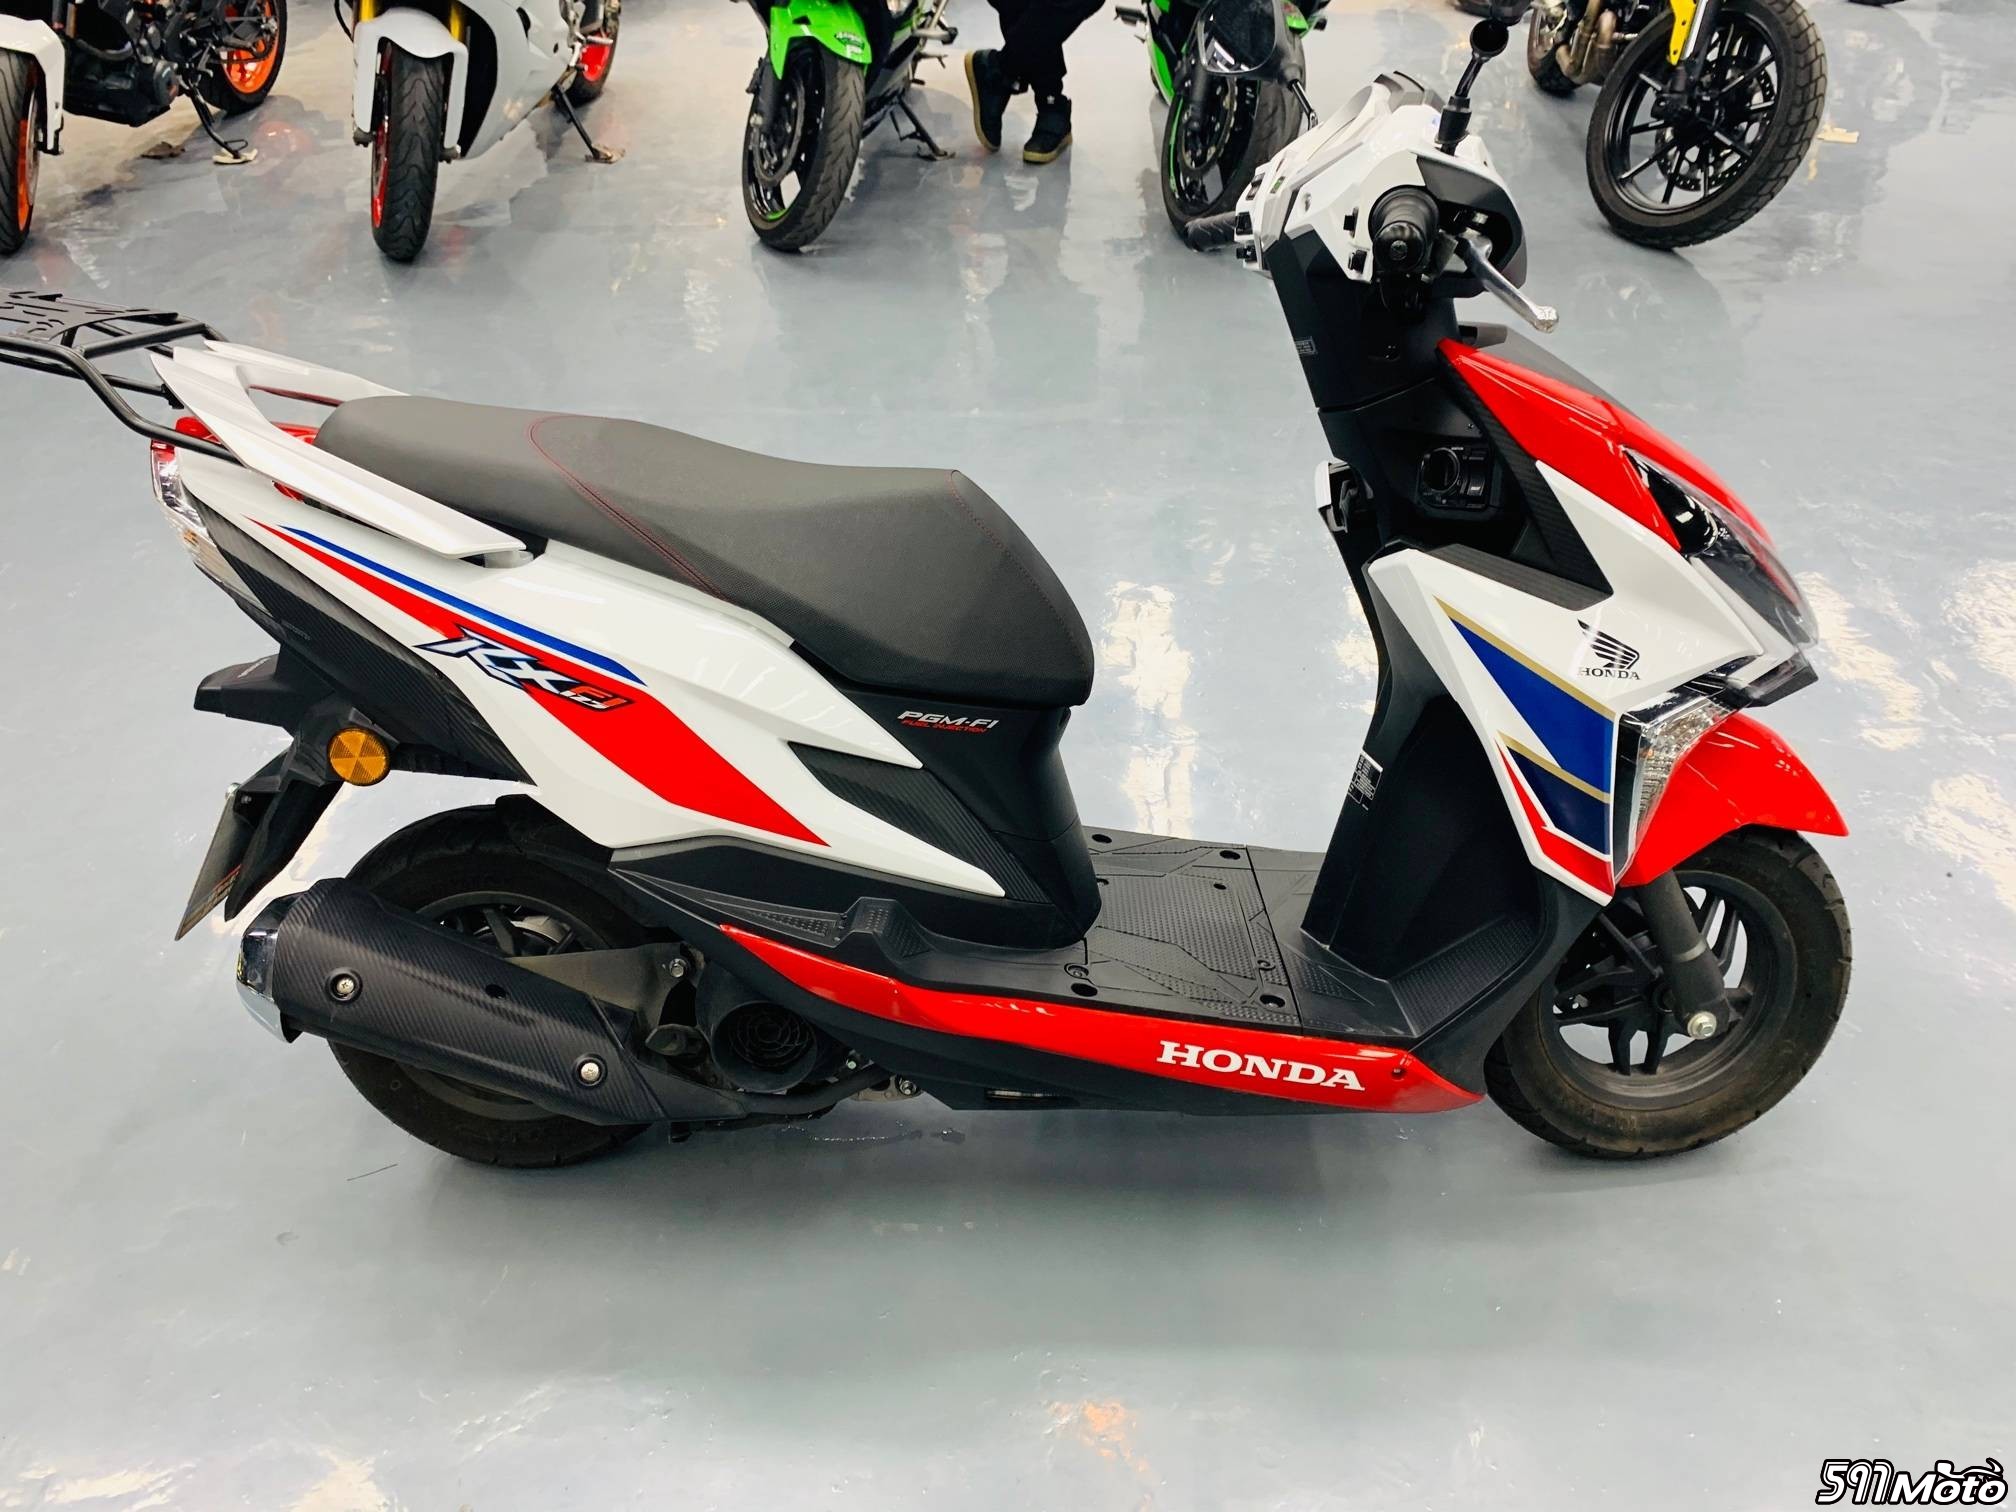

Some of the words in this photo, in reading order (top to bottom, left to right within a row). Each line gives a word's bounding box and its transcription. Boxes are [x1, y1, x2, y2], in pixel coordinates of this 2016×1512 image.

[413, 624, 582, 695] RX
[1577, 667, 1641, 680] HONDA
[1156, 1040, 1366, 1092] HONDA
